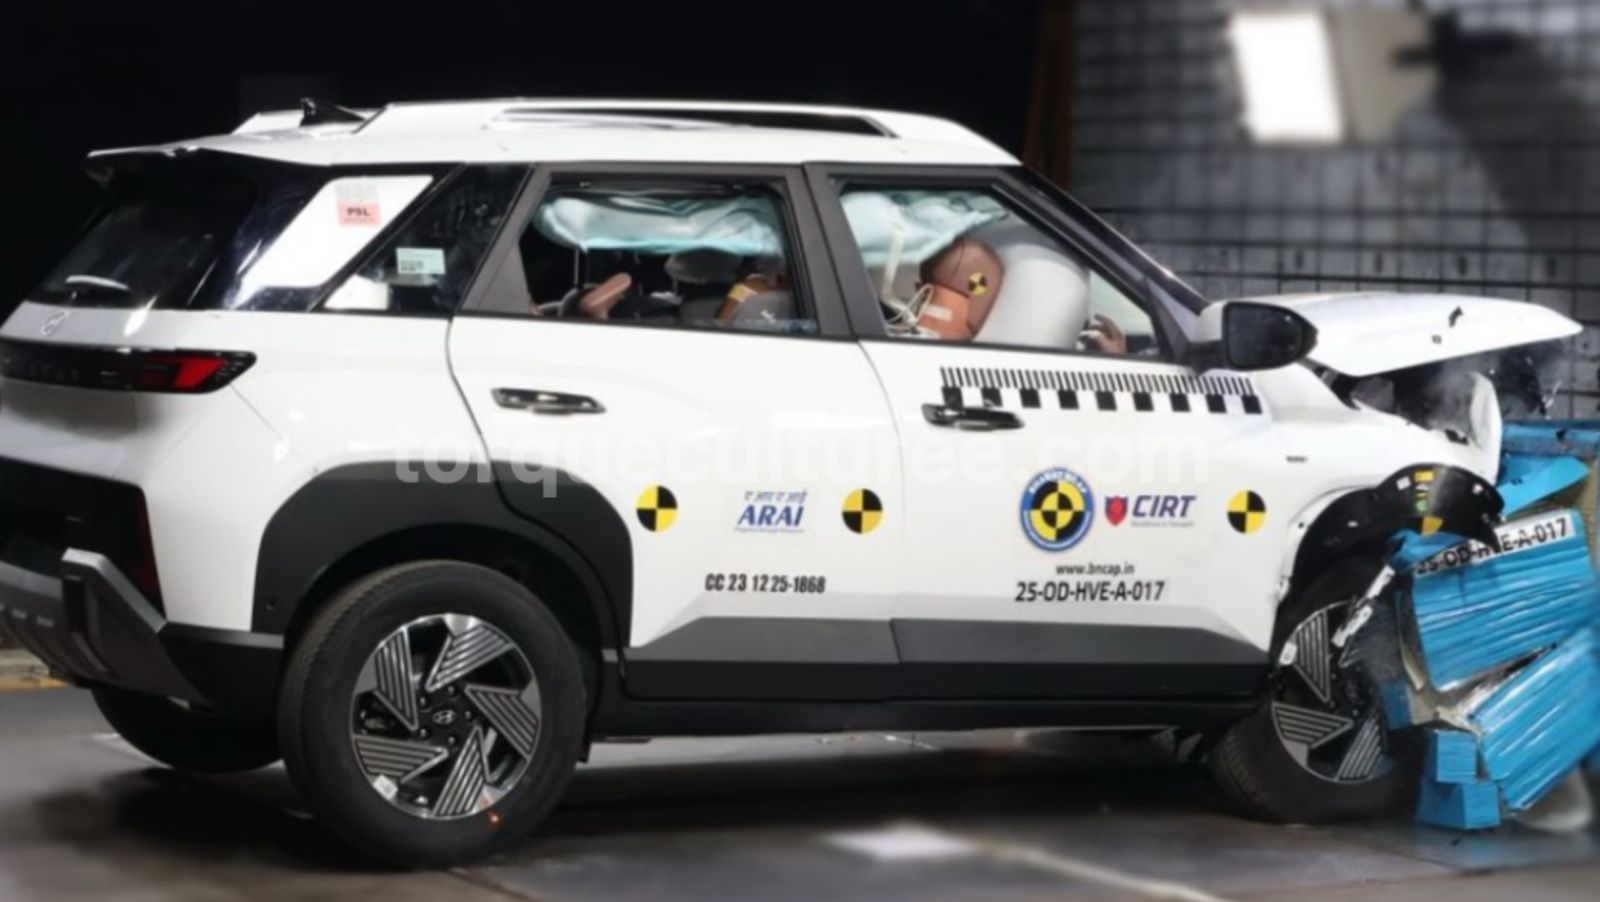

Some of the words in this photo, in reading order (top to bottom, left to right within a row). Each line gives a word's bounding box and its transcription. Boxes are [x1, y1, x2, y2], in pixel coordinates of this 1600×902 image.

[737, 504, 804, 527] ARAI
[1132, 495, 1197, 518] CIRT
[1055, 562, 1135, 576] www.bncap.in
[704, 573, 725, 592] CC
[727, 573, 747, 592] 23
[1015, 580, 1166, 602] 25-OD-HVE-A-017
